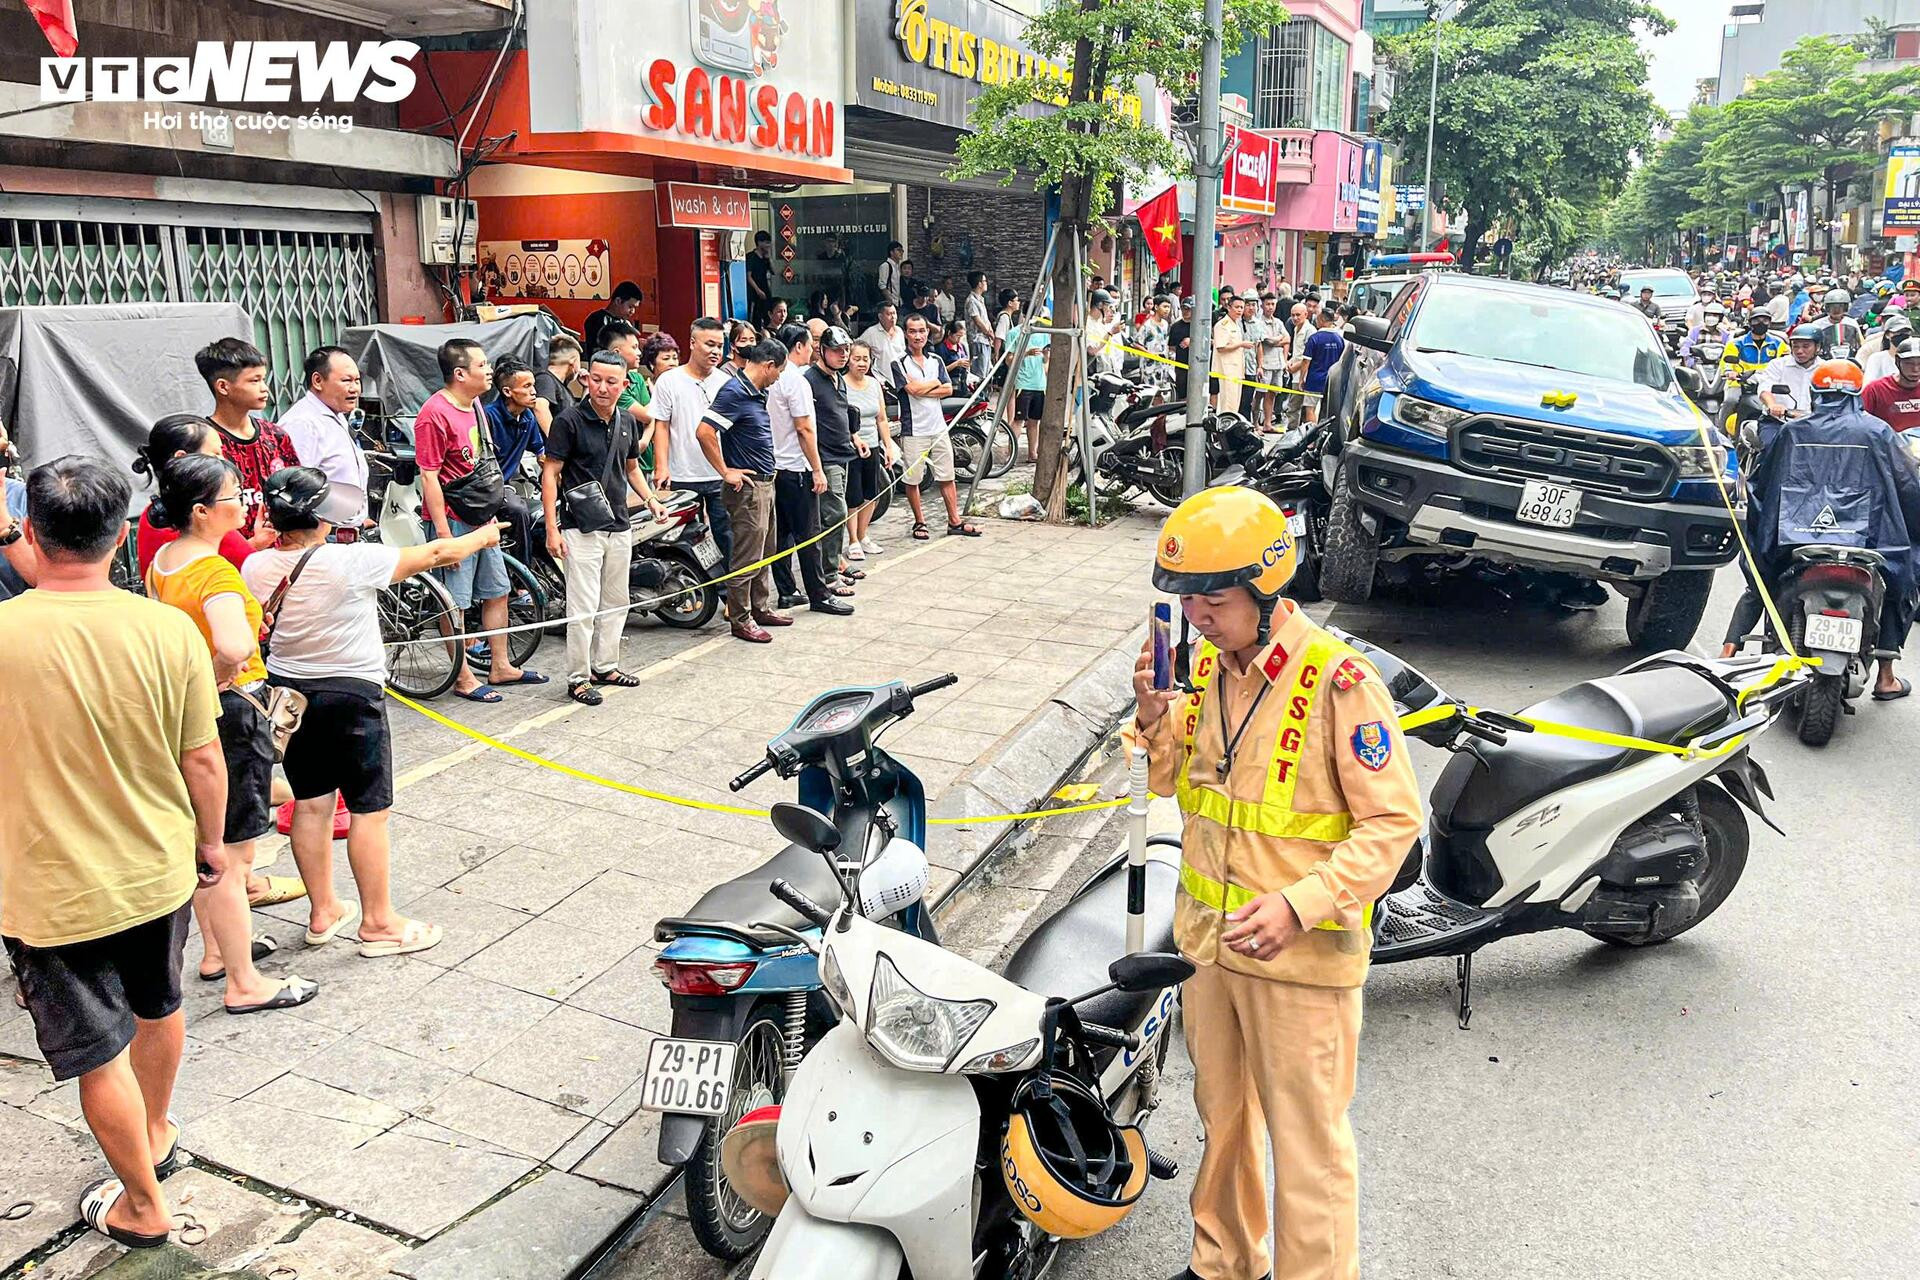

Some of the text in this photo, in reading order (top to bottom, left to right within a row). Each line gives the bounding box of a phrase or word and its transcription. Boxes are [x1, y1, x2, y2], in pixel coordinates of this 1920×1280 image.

[900, 2, 977, 80] OTIS
[674, 196, 748, 223] wash & dry
[796, 226, 815, 234] OTIS
[864, 224, 887, 233] CLUB
[1537, 485, 1570, 505] 30F
[1519, 501, 1573, 525] 498.43
[659, 1043, 722, 1077] 29-P1
[651, 1076, 725, 1110] 100.66
